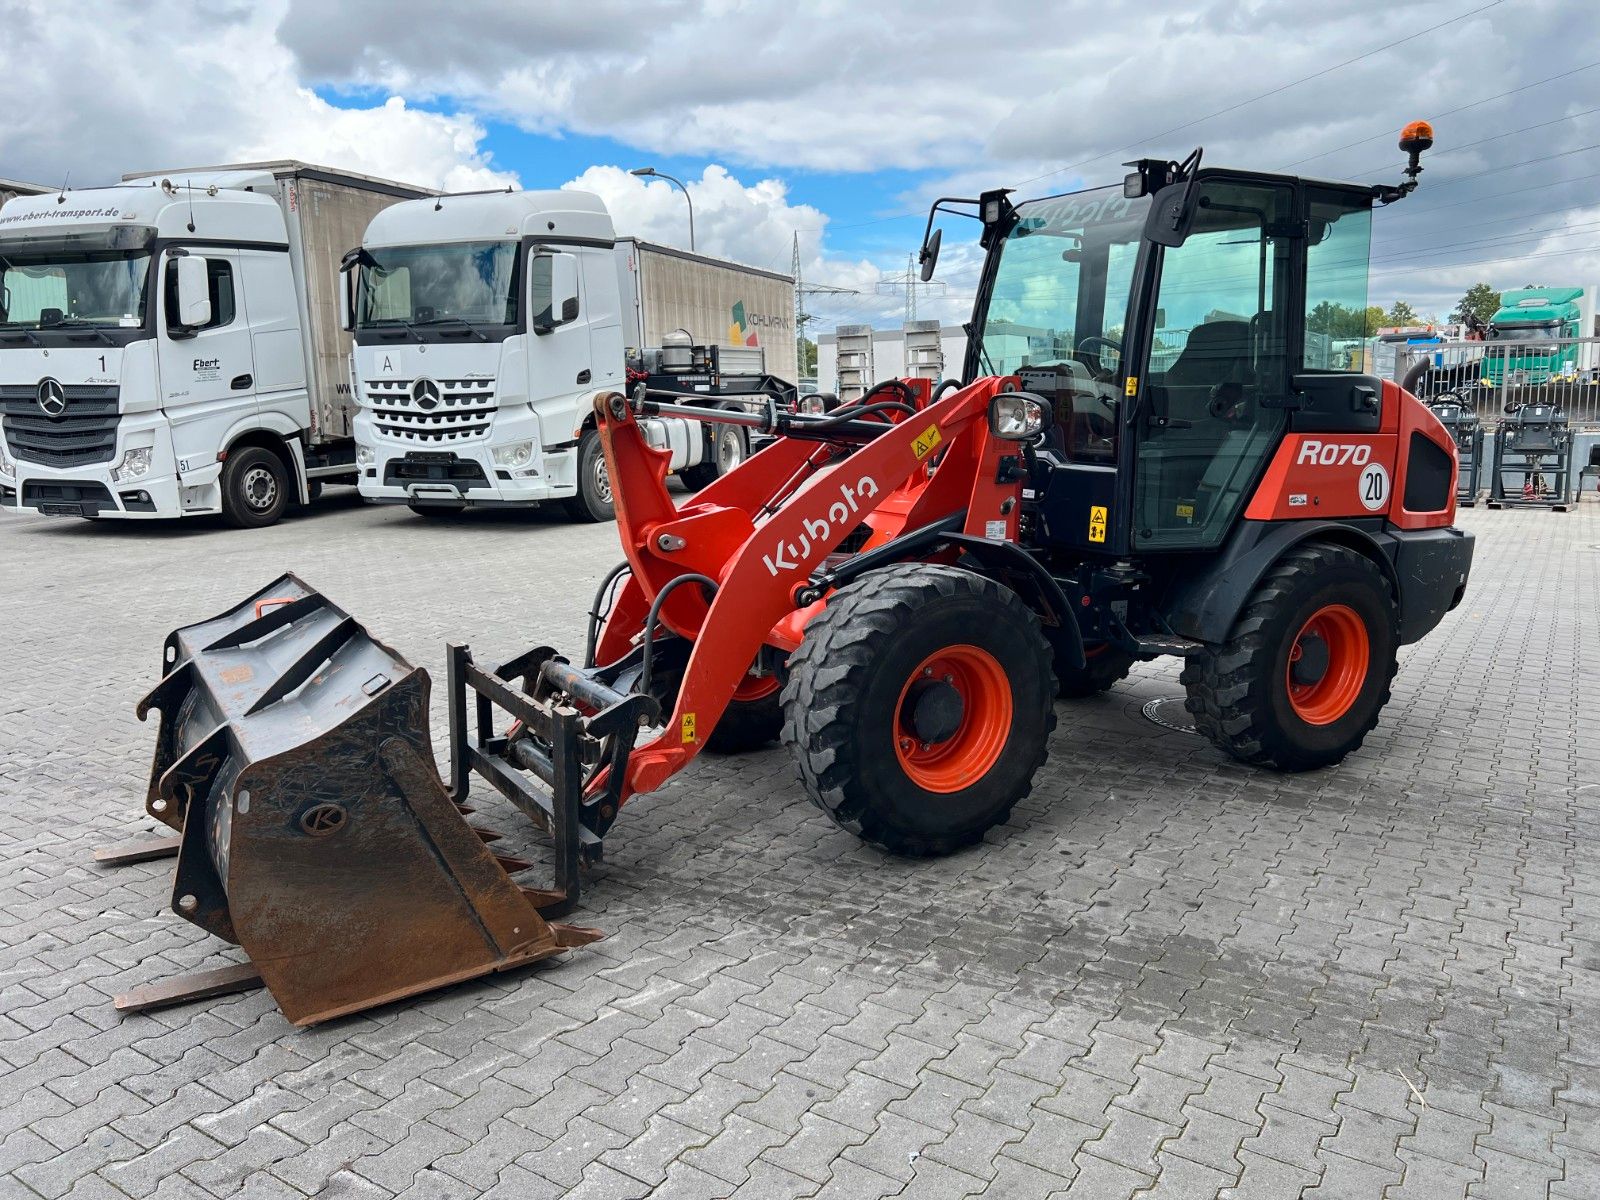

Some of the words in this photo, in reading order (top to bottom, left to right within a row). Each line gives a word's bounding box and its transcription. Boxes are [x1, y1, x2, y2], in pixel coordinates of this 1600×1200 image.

[0, 207, 119, 224] www.ebert-transport.de
[746, 312, 789, 329] KOHLMANN
[98, 355, 105, 372] 1
[193, 358, 220, 371] Ebert
[383, 356, 393, 371] A
[1297, 440, 1371, 465] R070
[180, 460, 190, 471] 51
[1365, 472, 1383, 501] 20
[762, 475, 879, 577] Kubota
